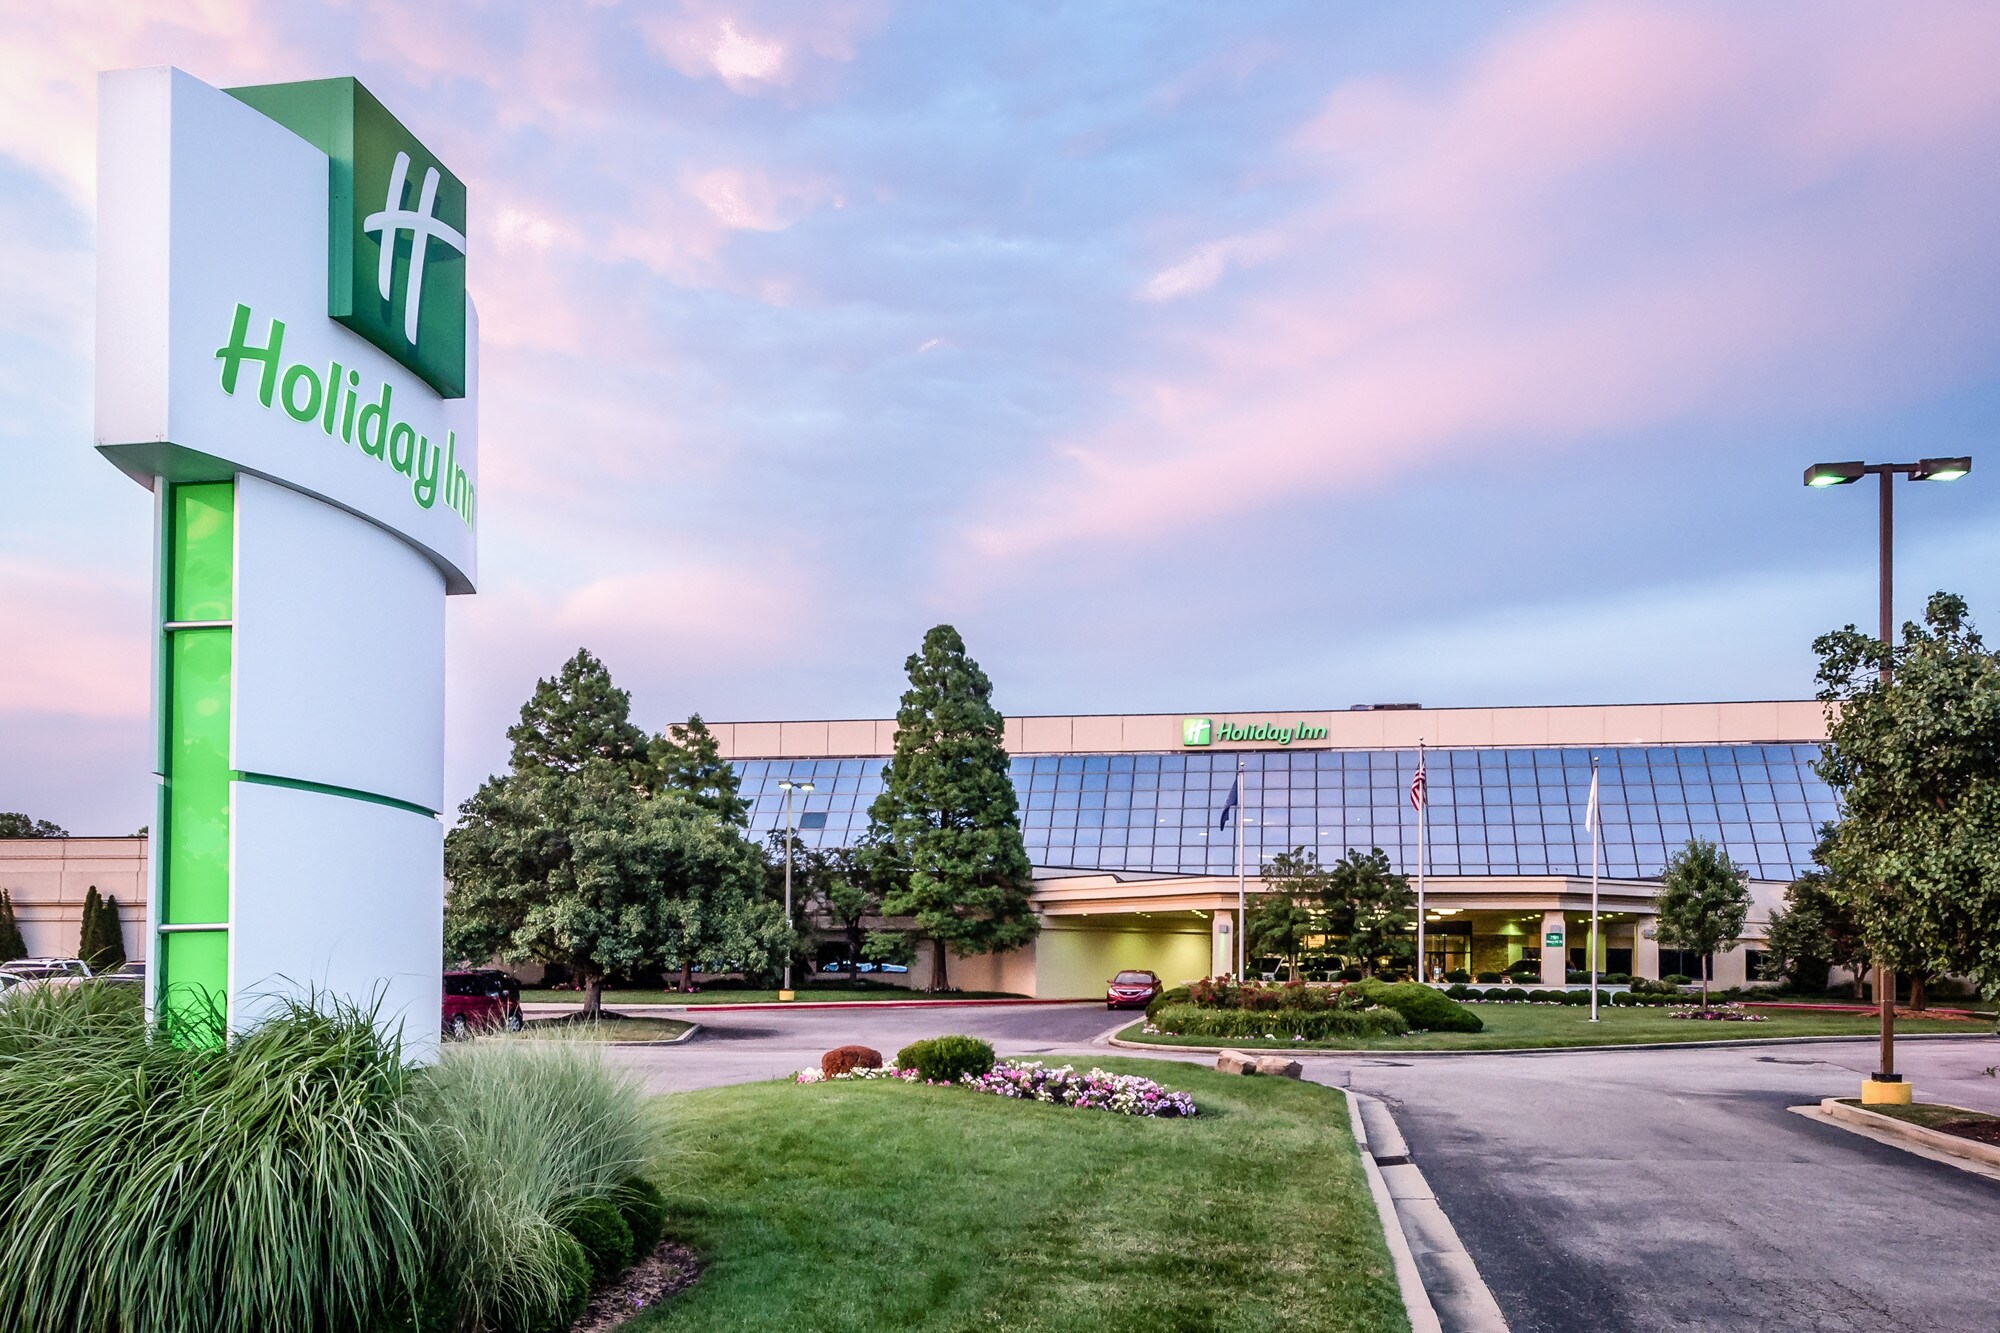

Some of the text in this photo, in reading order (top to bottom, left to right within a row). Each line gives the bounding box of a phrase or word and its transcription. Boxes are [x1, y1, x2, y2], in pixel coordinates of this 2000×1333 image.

[214, 302, 475, 533] Holiday Inn
[1216, 721, 1328, 745] Holiday Inn
